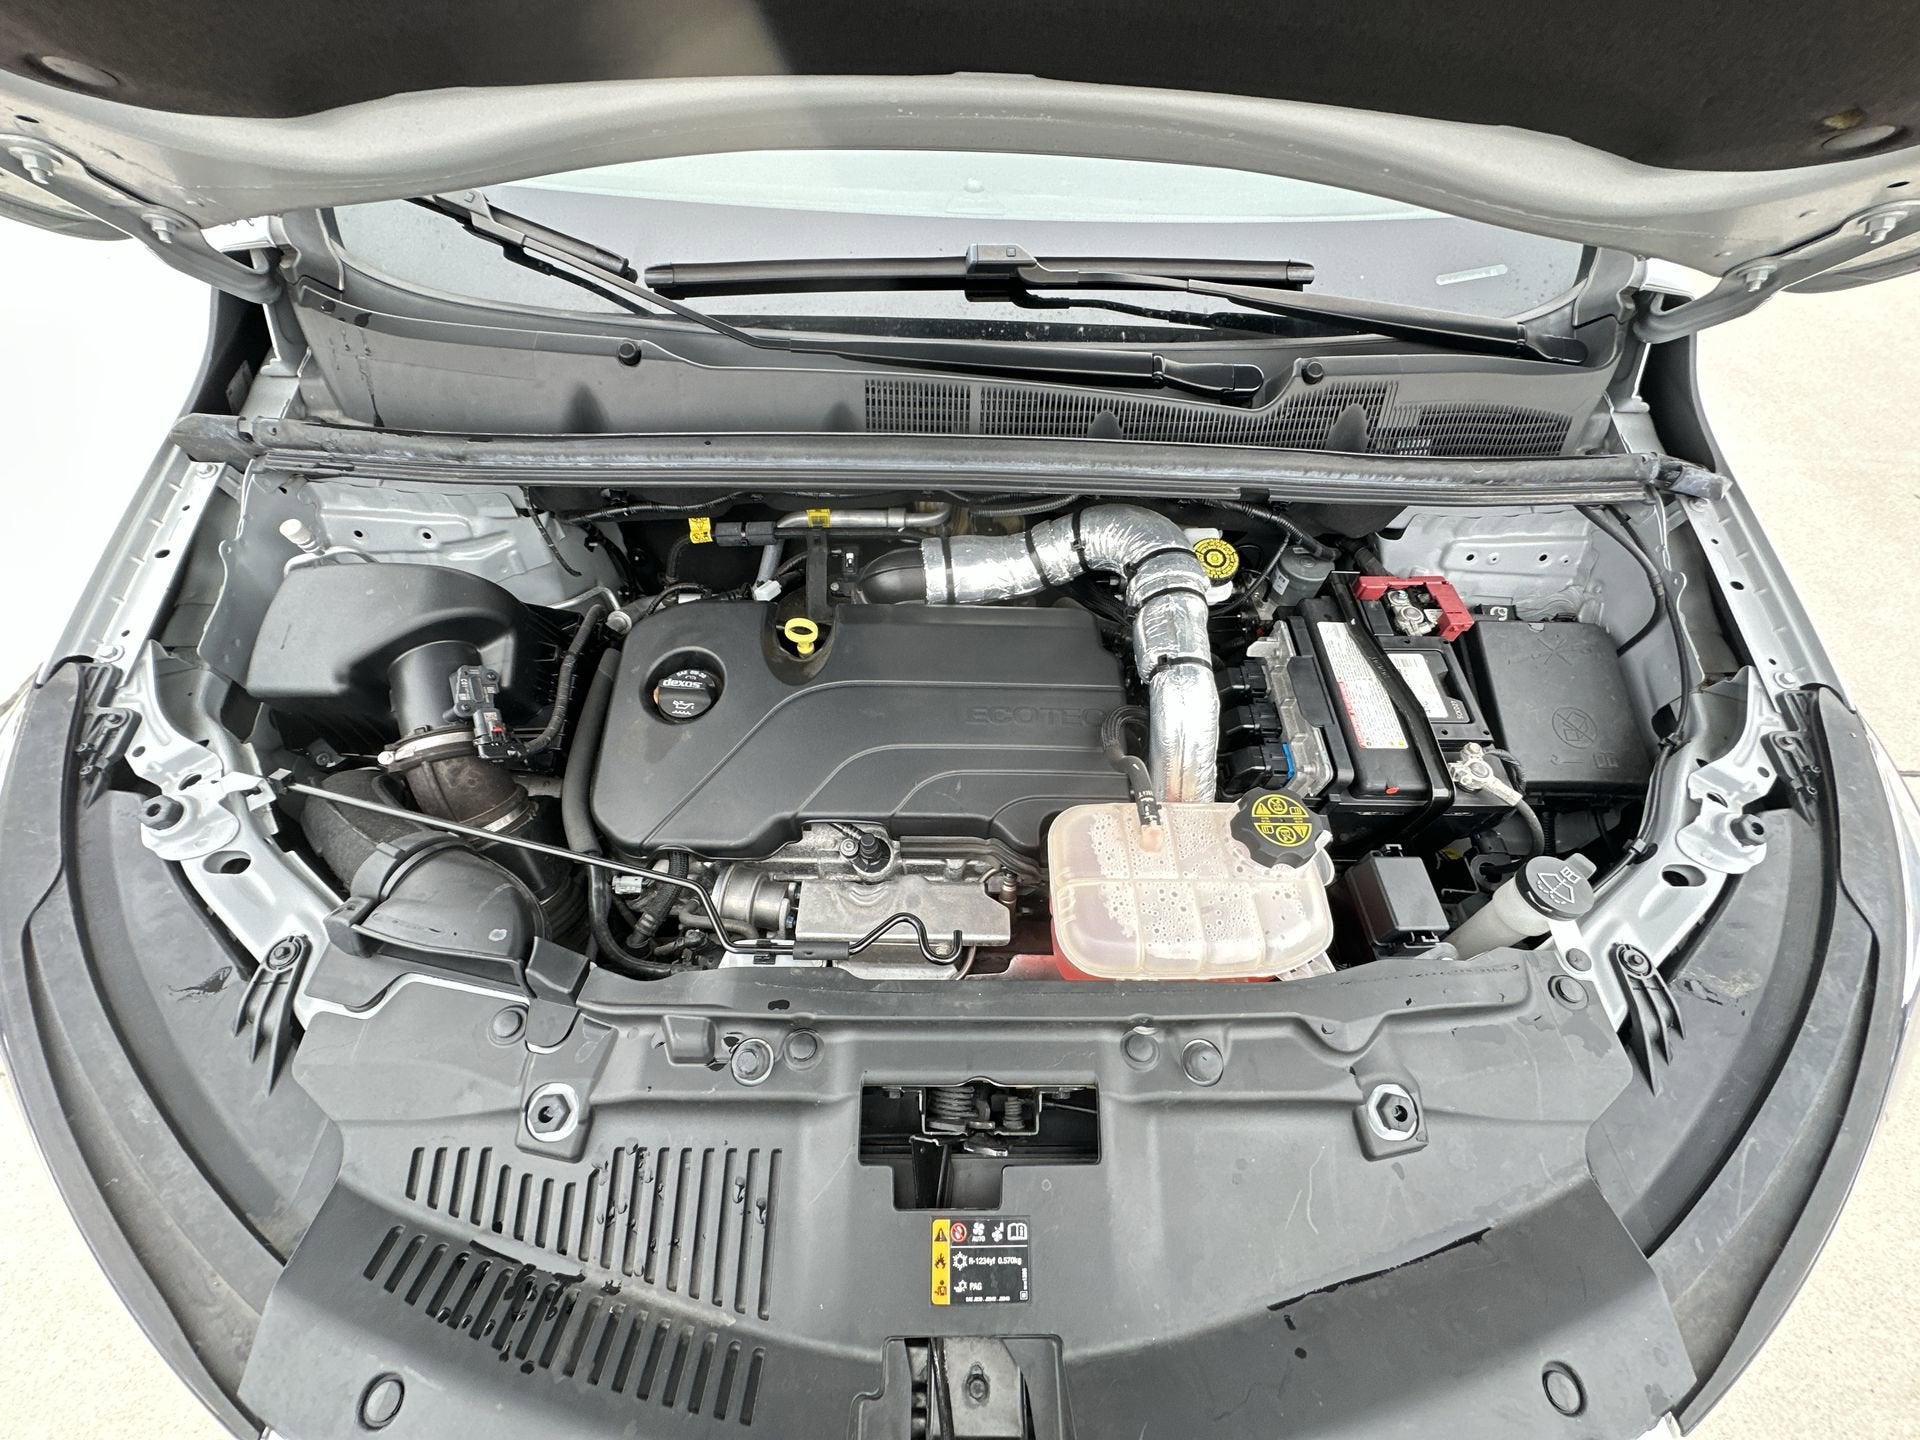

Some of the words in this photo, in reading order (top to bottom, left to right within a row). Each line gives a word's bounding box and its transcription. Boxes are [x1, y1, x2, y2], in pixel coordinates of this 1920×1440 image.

[662, 678, 703, 688] dexos
[966, 705, 1105, 725] ECOTEC
[971, 1235, 986, 1243] AUTO
[969, 1282, 983, 1291] PAG
